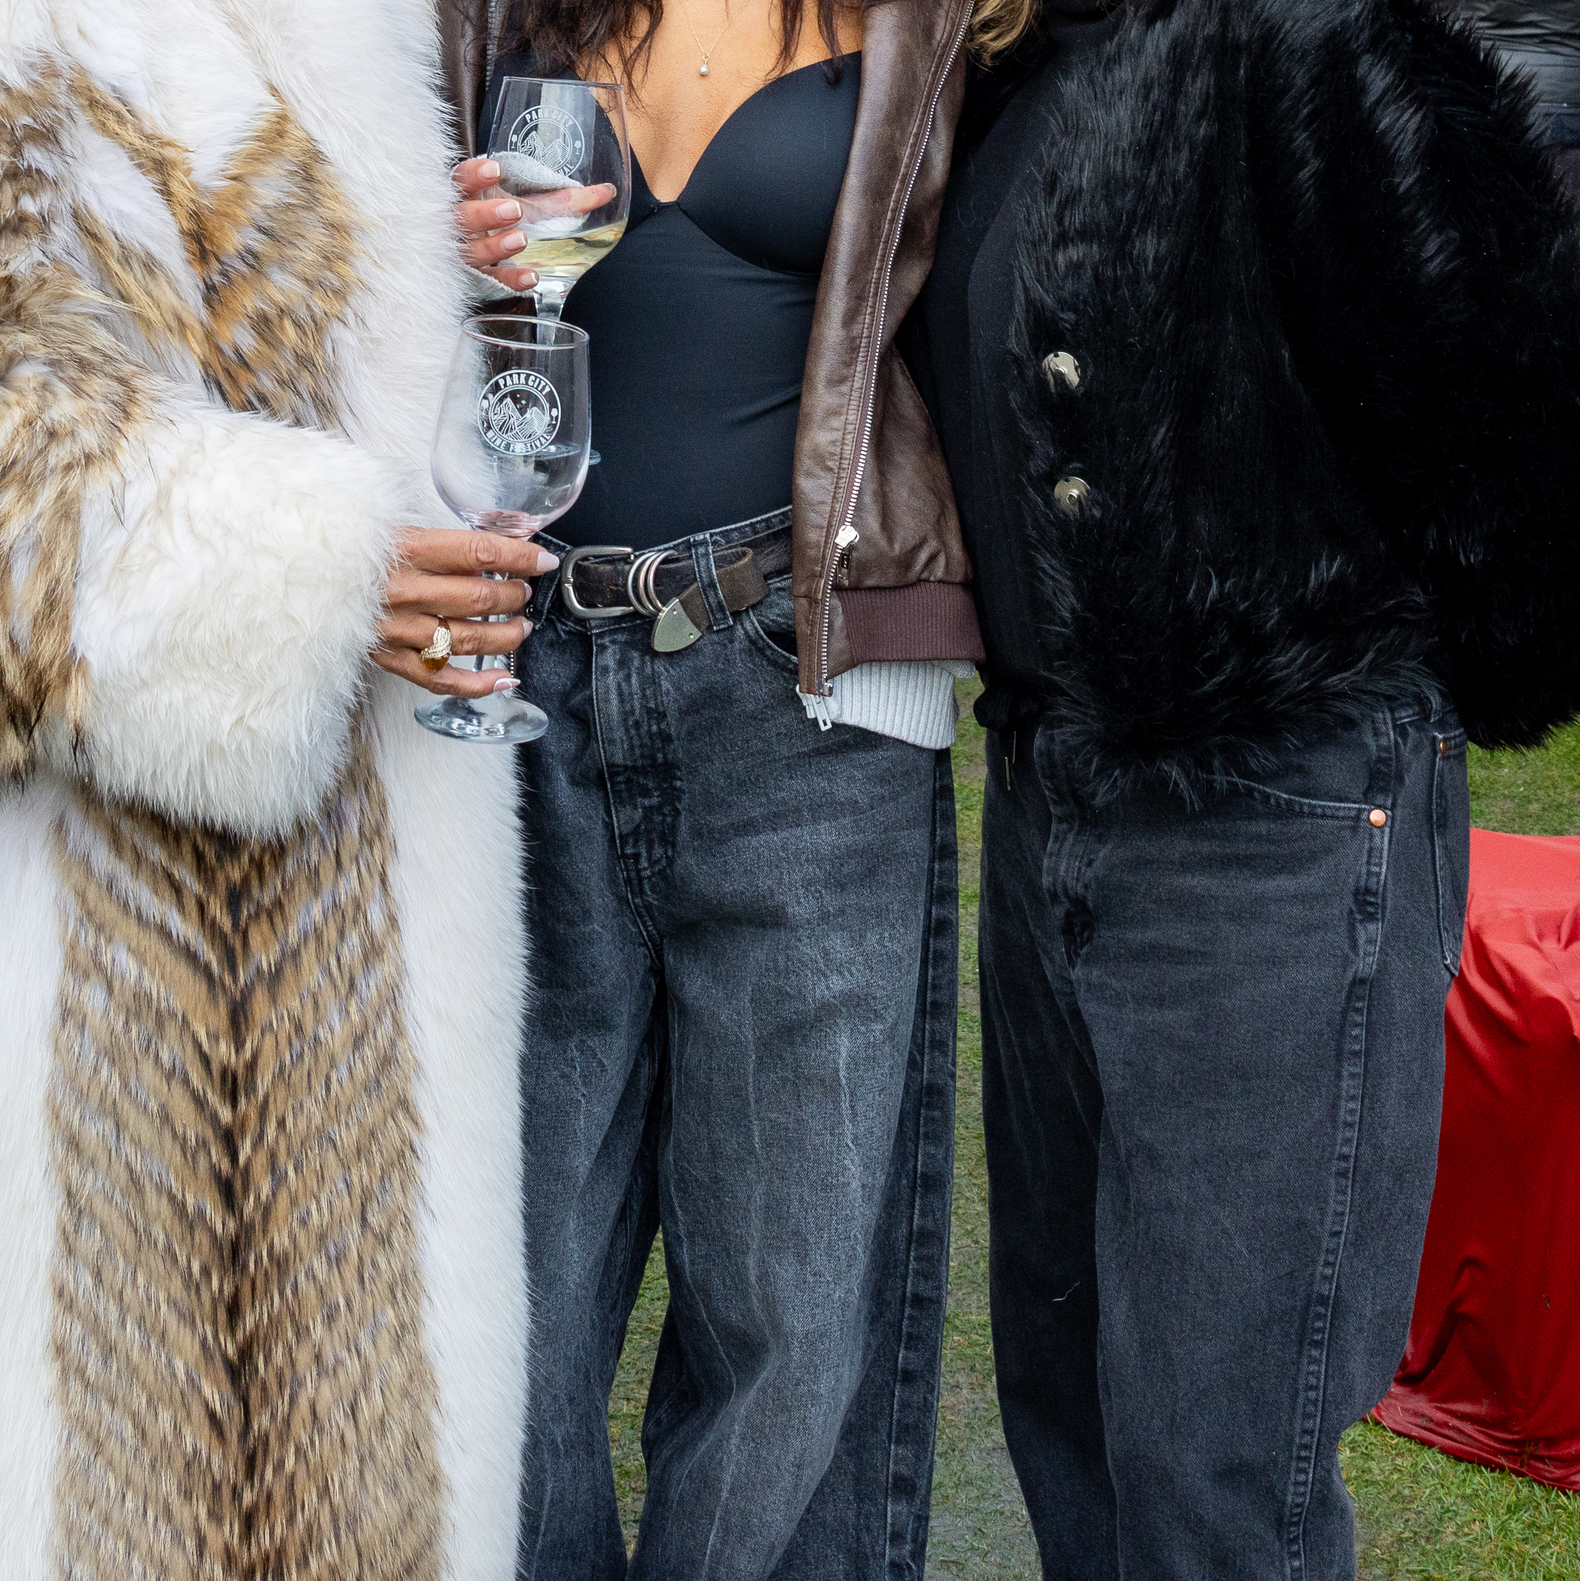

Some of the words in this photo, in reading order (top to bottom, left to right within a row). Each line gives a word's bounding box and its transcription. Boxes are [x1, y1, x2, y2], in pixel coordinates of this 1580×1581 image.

[525, 108, 550, 123] PARK
[551, 109, 574, 127] CITY
[498, 373, 526, 389] PARK
[527, 375, 551, 395] CITY
[485, 429, 509, 450] WINE
[509, 432, 551, 453] FSTIVAL
